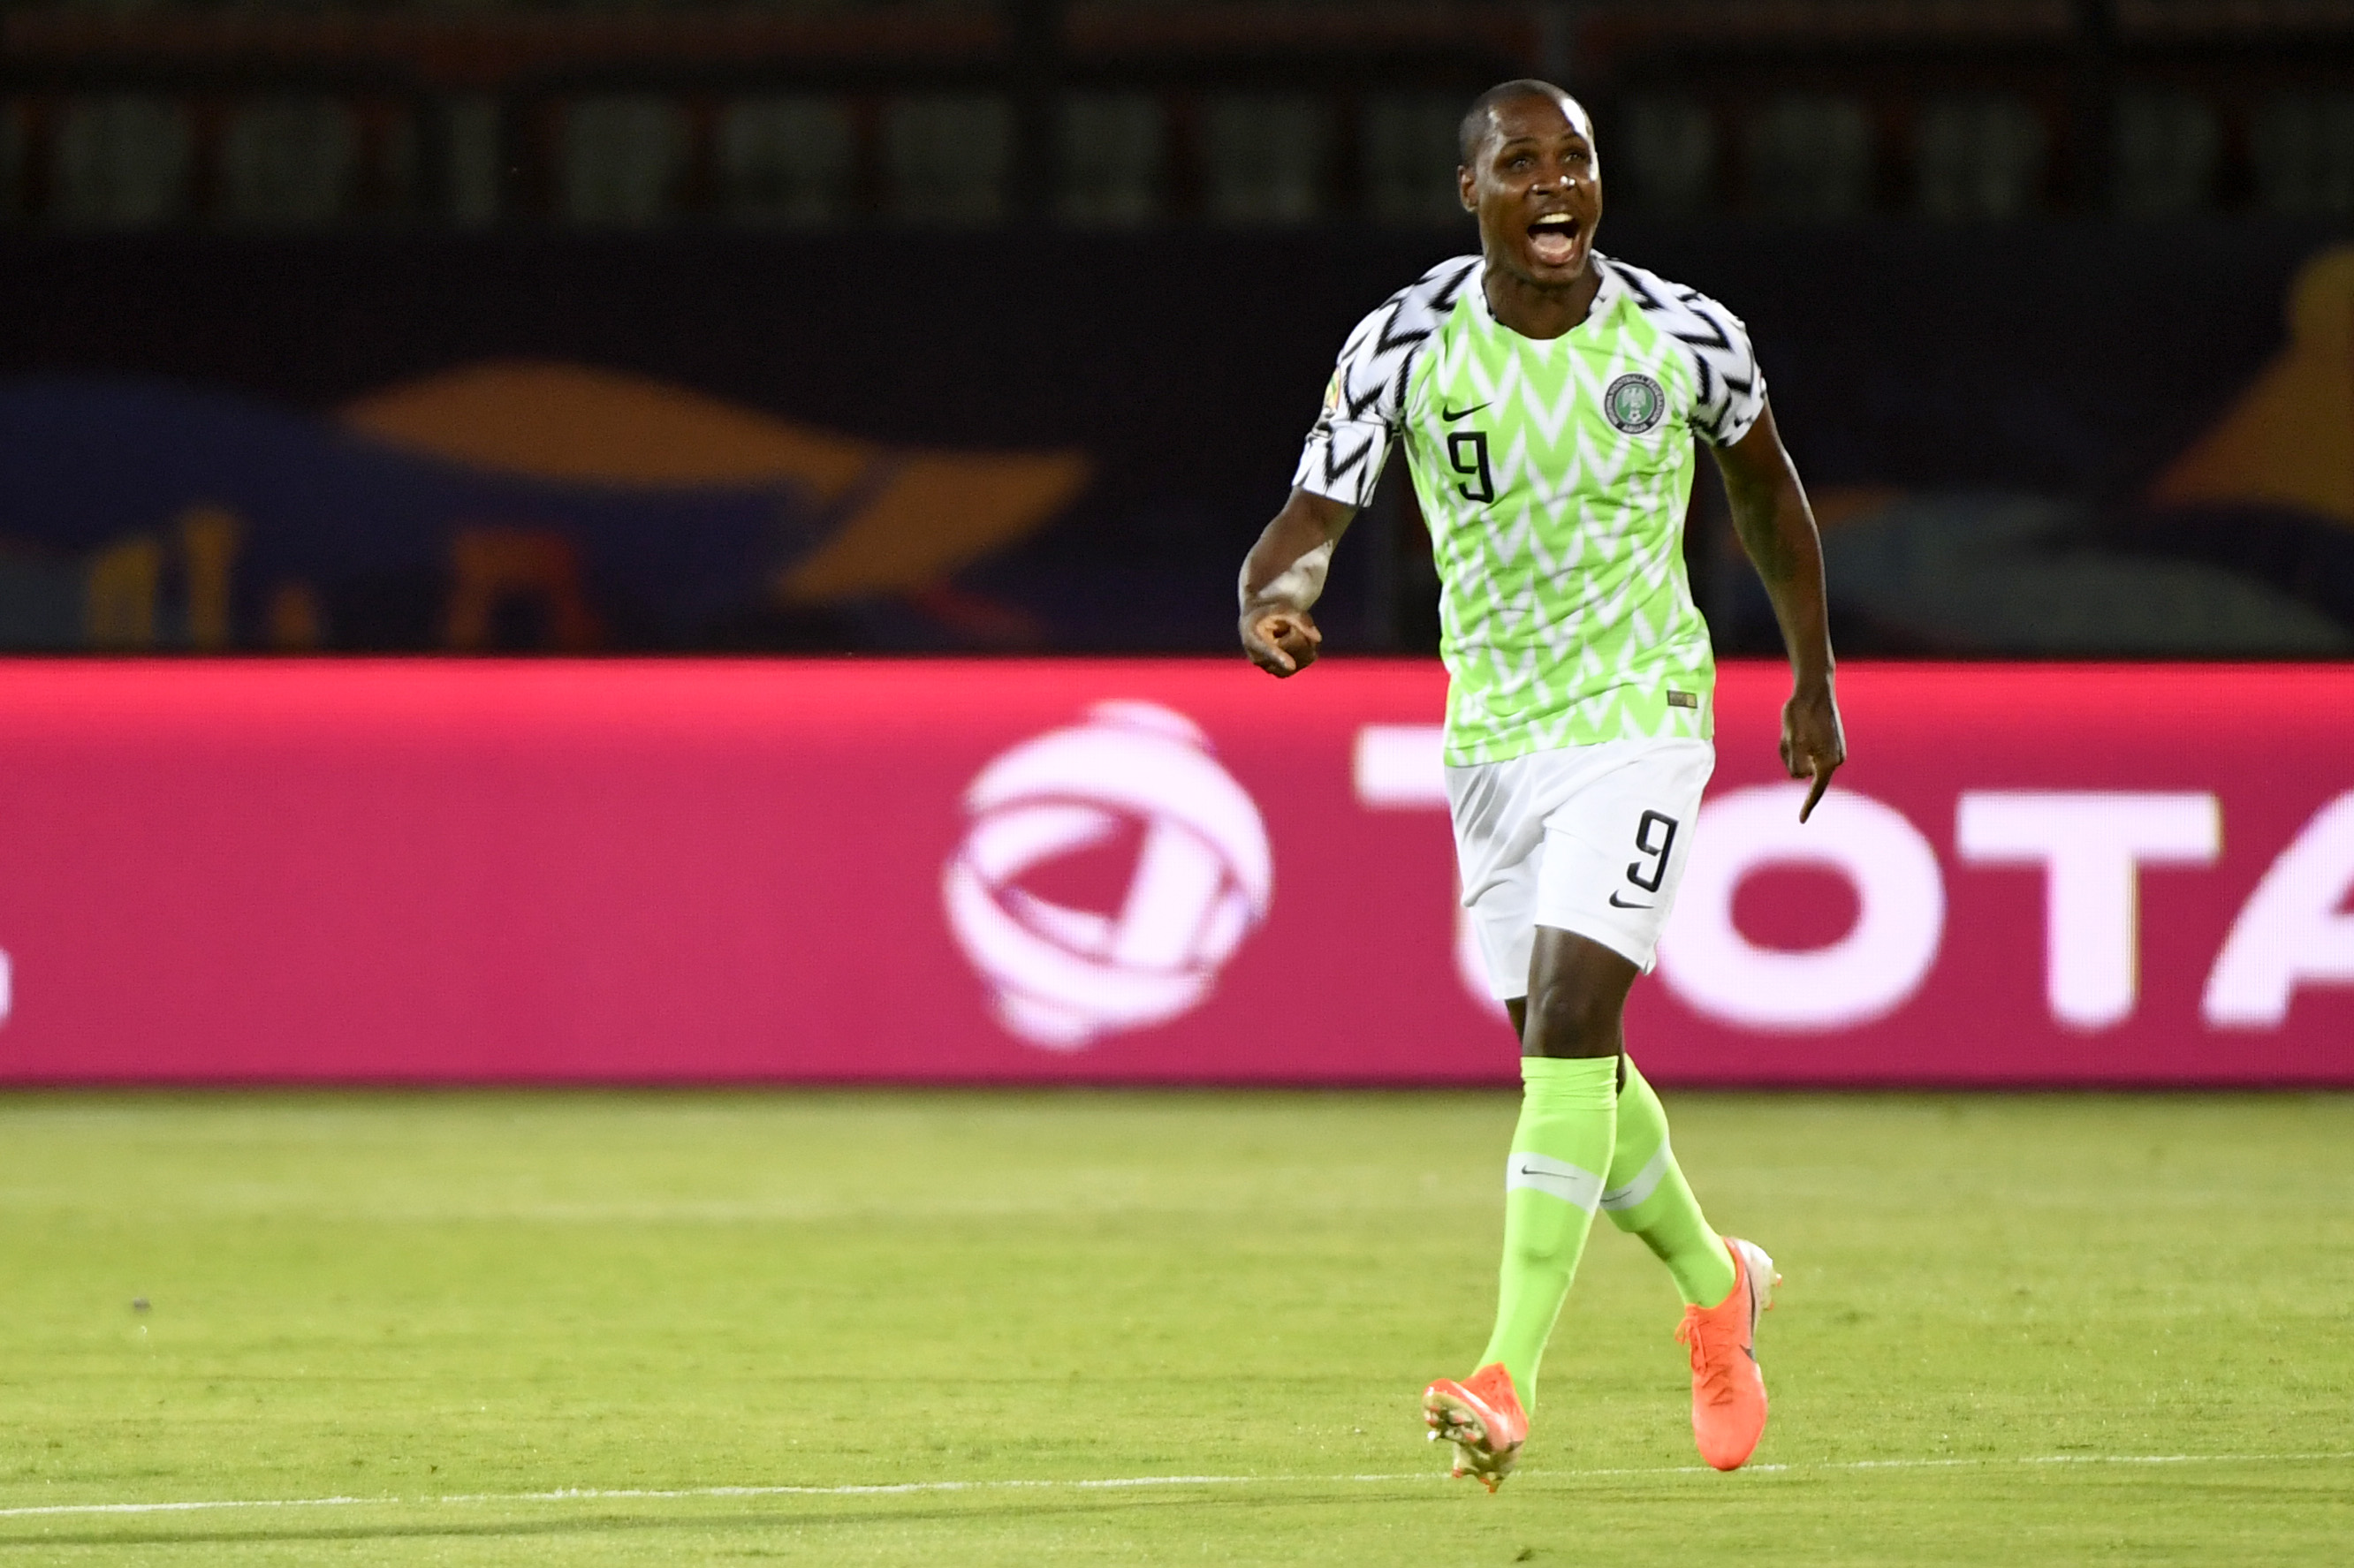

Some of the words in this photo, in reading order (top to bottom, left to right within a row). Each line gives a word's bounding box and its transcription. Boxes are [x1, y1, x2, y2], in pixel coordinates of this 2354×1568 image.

[1447, 431, 1493, 504] 9
[1355, 723, 2354, 1034] OTA
[1627, 809, 1679, 893] 9
